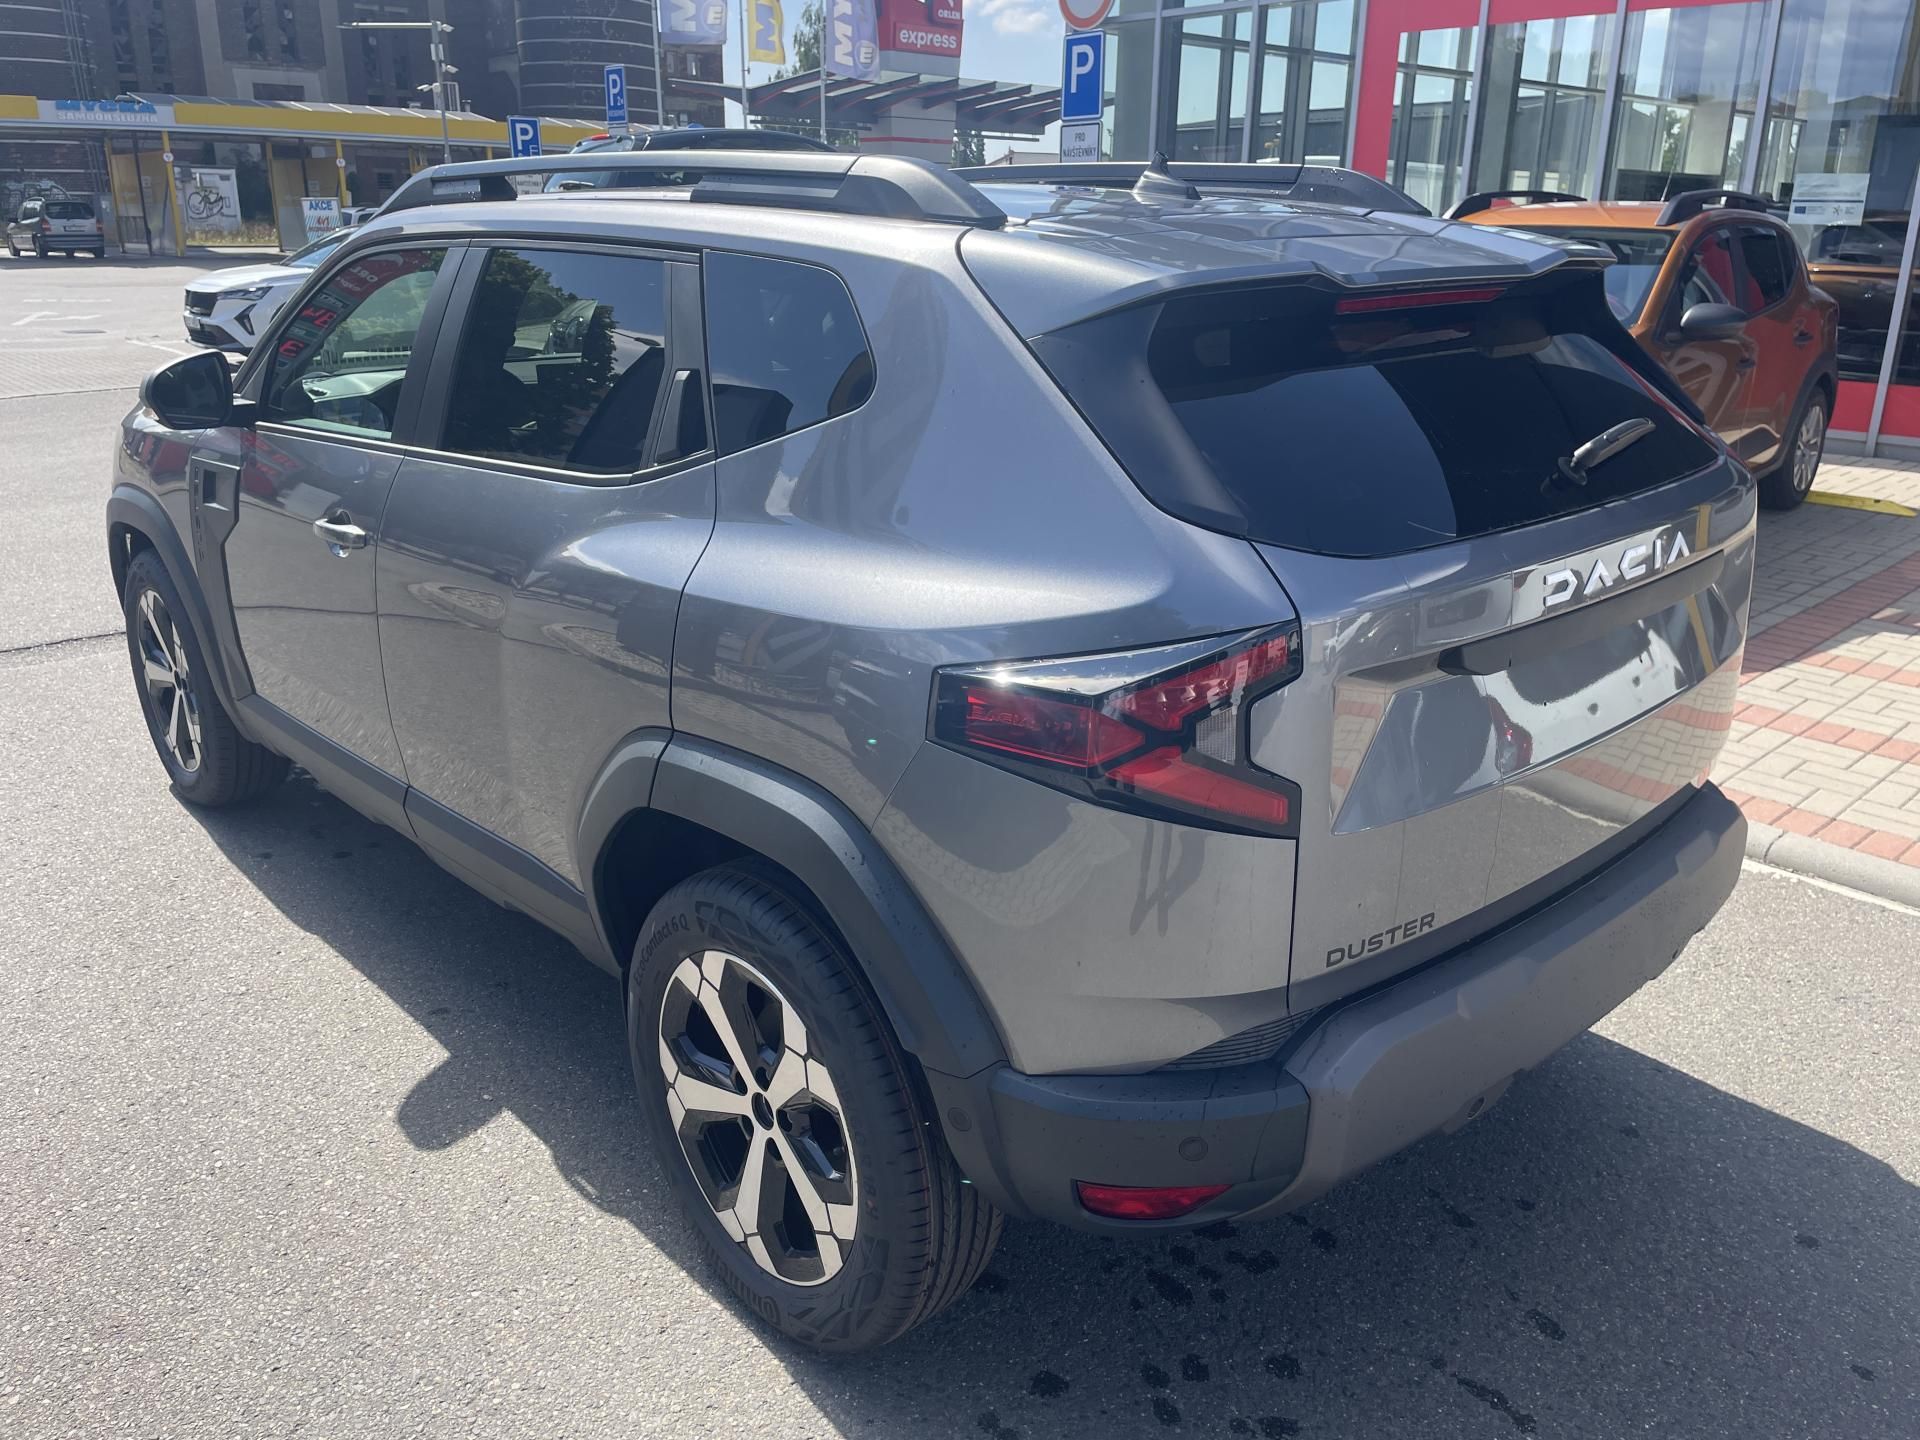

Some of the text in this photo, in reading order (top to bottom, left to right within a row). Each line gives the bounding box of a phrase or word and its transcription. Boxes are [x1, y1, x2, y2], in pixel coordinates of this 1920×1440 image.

[938, 9, 961, 19] ORLEN
[899, 29, 958, 48] express
[1070, 44, 1095, 93] P
[608, 73, 621, 106] P
[515, 123, 534, 150] P
[1074, 132, 1086, 143] PRO
[309, 200, 333, 211] AKCE
[1542, 530, 1690, 607] DACIA
[633, 920, 672, 986] EcoContact
[1325, 911, 1435, 968] DUSTER
